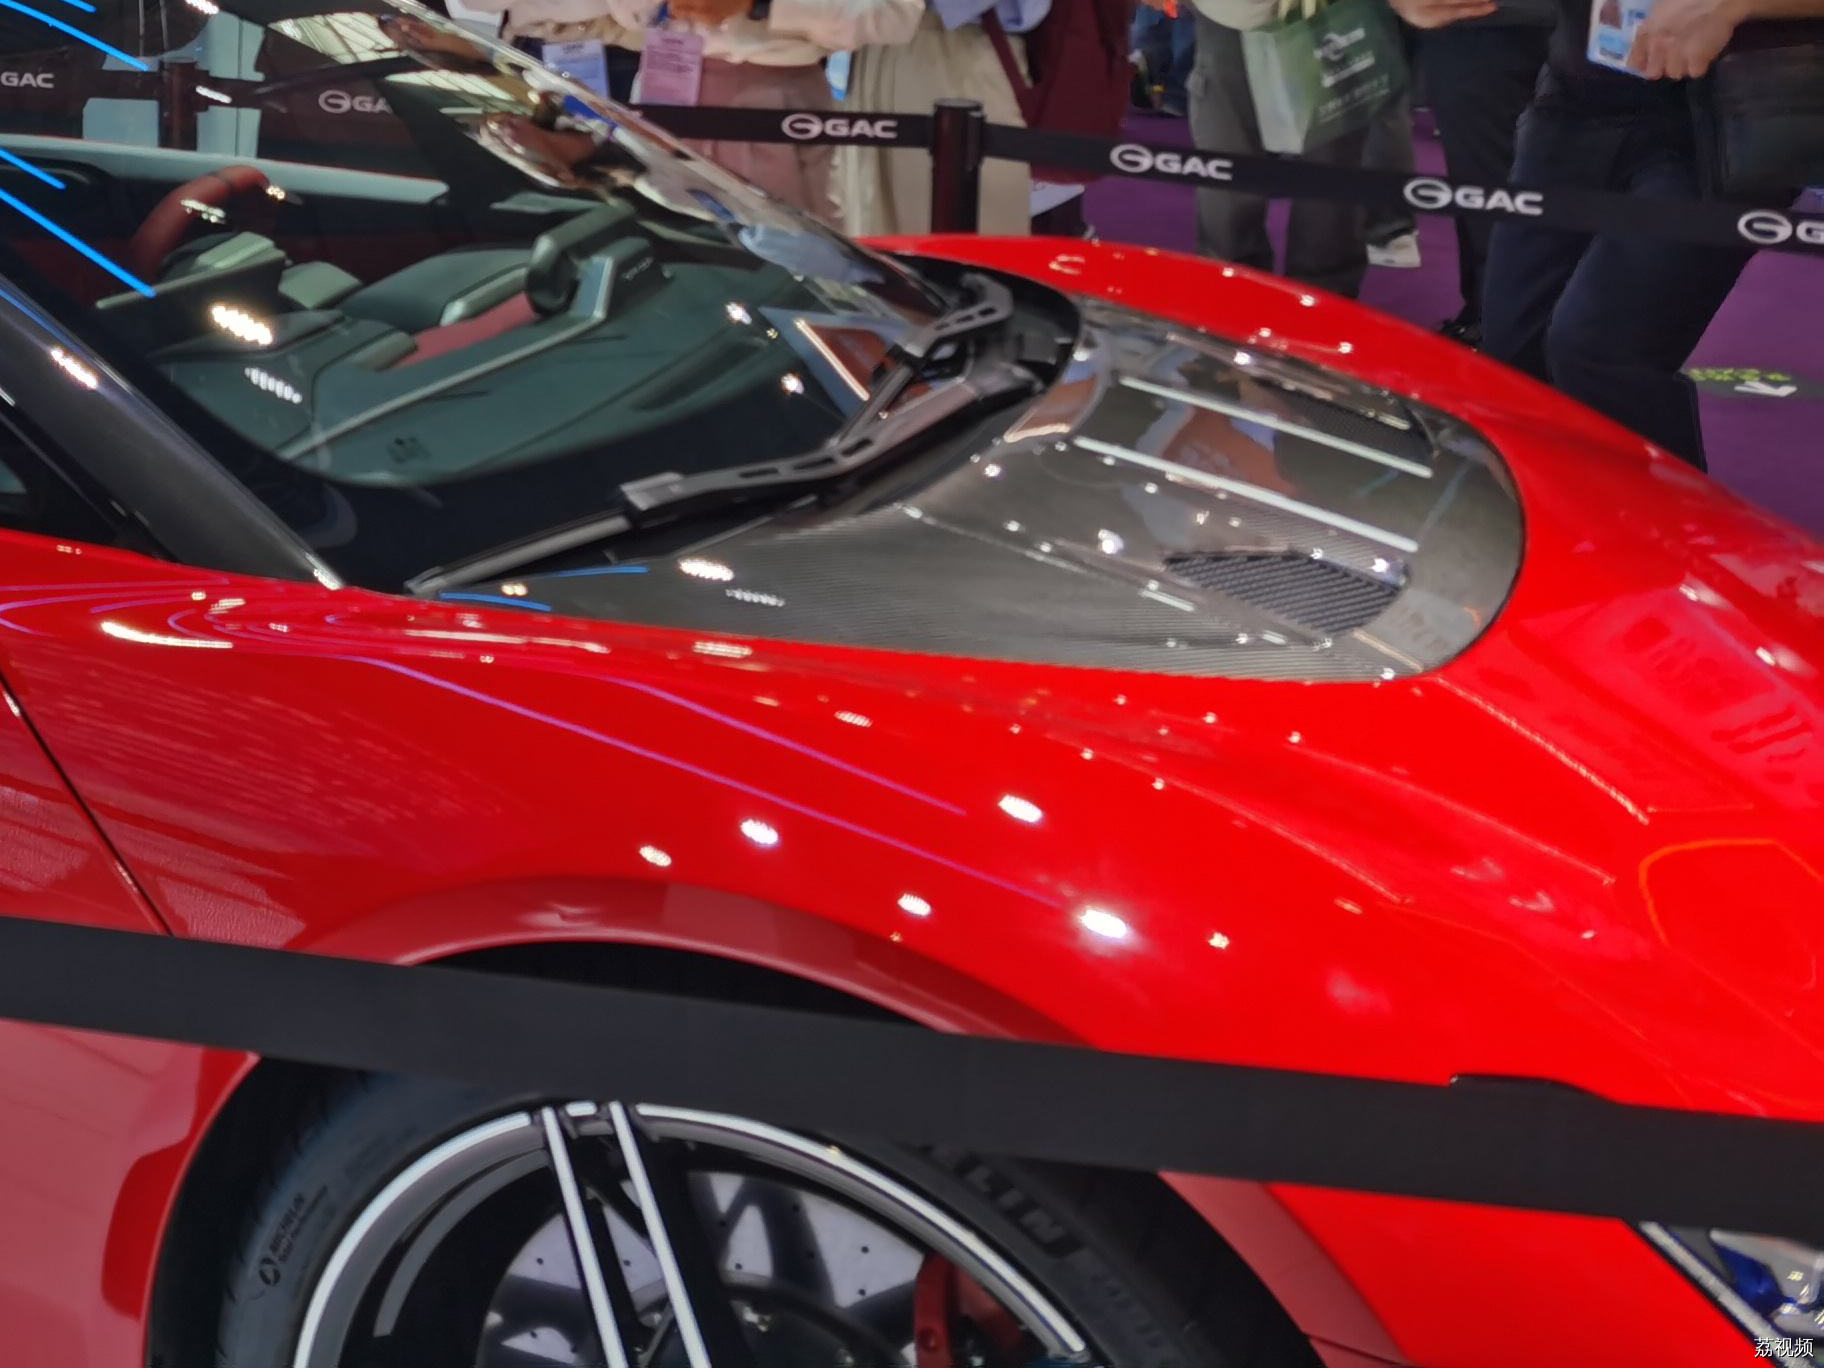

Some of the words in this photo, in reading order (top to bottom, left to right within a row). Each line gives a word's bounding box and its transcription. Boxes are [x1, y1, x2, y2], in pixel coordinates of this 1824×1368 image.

[823, 117, 899, 140] GAC
[1153, 150, 1235, 182] GAC
[1453, 186, 1545, 217] GAC
